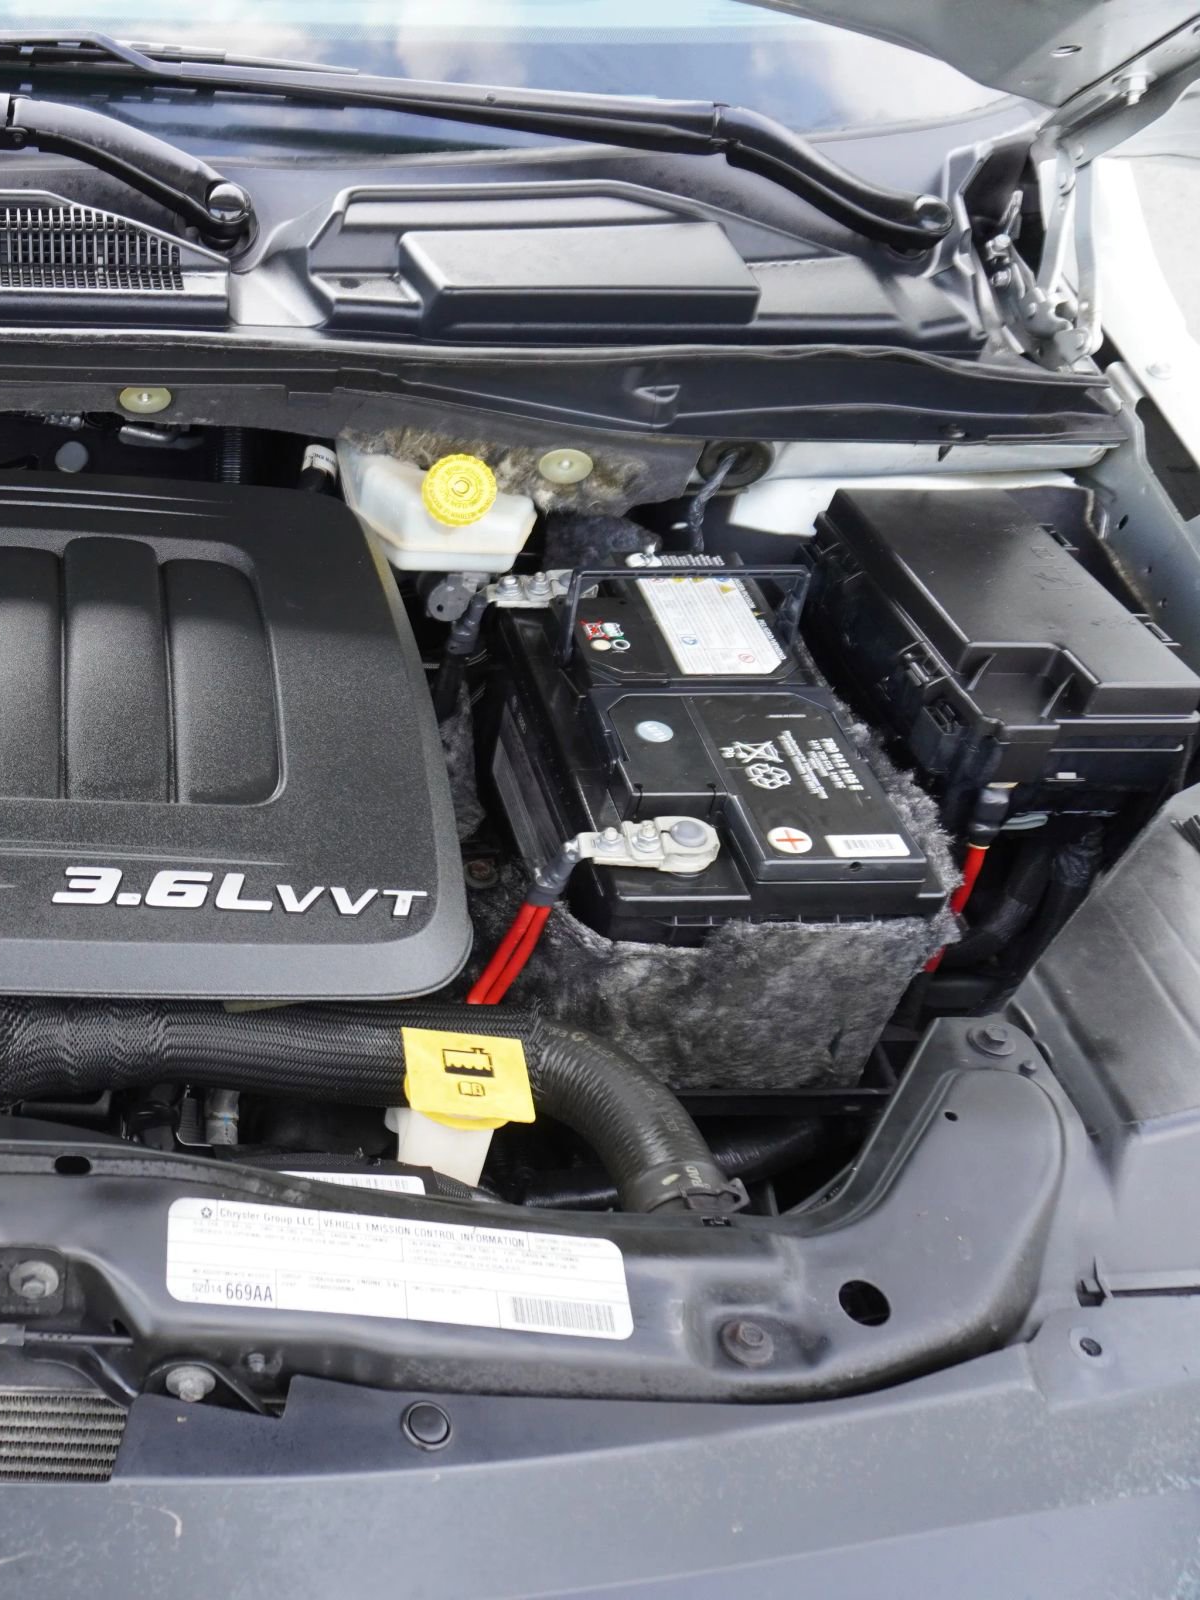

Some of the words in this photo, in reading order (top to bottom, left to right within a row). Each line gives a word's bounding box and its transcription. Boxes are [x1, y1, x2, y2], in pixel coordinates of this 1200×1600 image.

[219, 1207, 260, 1221] Chrysler
[263, 1214, 293, 1226] Group
[296, 1216, 315, 1227] LLC
[324, 1219, 362, 1232] VEHICLE
[366, 1223, 411, 1236] EMISSION
[414, 1227, 456, 1241] CONTROL
[460, 1231, 525, 1248] INFORMATION
[225, 1282, 273, 1302] 669AA
